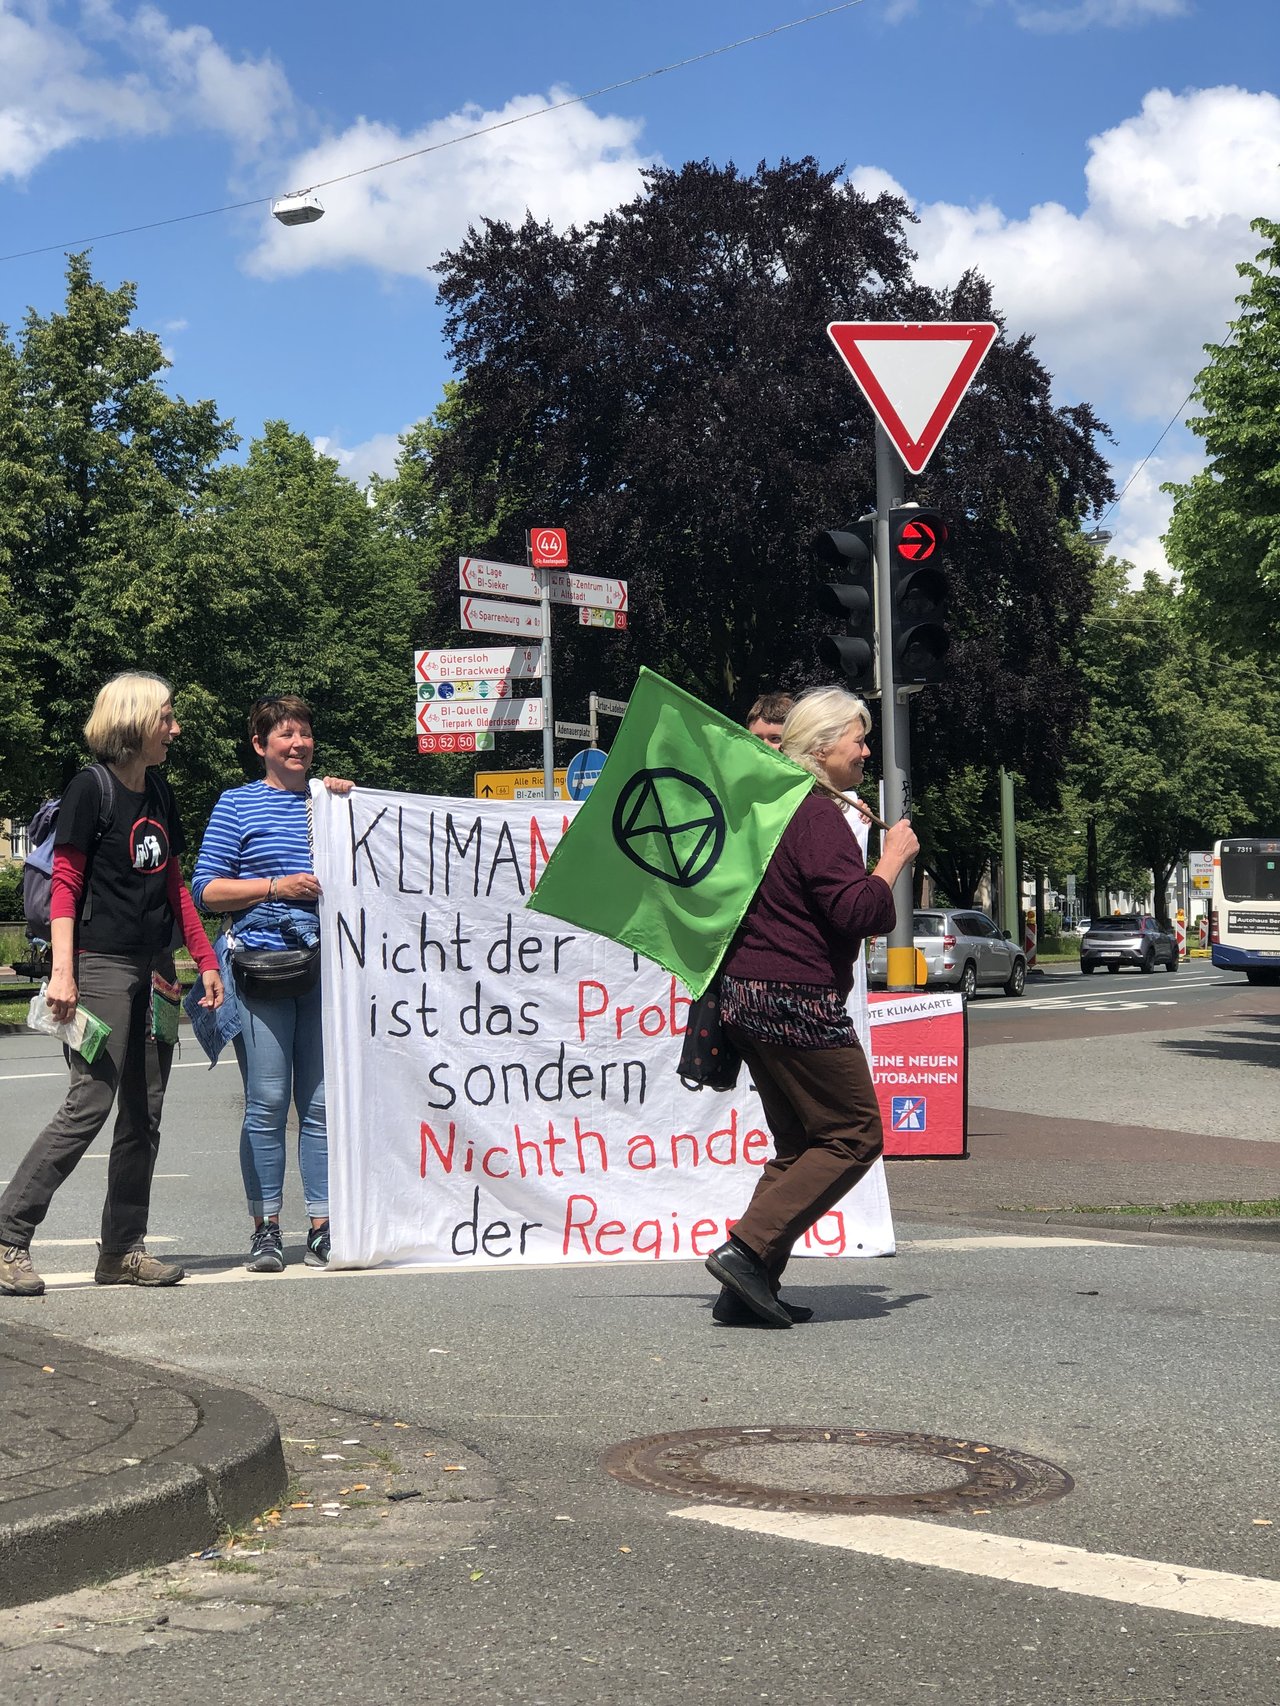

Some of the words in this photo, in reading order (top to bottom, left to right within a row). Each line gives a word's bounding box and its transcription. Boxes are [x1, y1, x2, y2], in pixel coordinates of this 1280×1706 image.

[541, 538, 558, 551] 44
[486, 566, 502, 578] Lage
[478, 578, 509, 591] BI-Sieker
[566, 579, 603, 592] BI-Zentrum
[560, 590, 586, 601] Altstadt
[479, 610, 520, 627] Sparrenburg
[617, 613, 626, 624] 21
[440, 654, 489, 664] Gütersloh
[523, 651, 532, 661] 18
[440, 665, 511, 677] BI-Brackwede
[441, 705, 489, 716] BI-Quelle
[442, 719, 473, 729] Tierpark
[476, 717, 520, 728] Olderdissen
[558, 725, 591, 738] Adenauerplatz
[421, 738, 434, 748] 53
[440, 737, 453, 748] 52
[459, 736, 472, 747] 50
[514, 778, 529, 786] Alle
[516, 790, 560, 799] BI-Zentm
[348, 799, 569, 897] KLIMAN
[337, 907, 473, 974] Nicht
[486, 912, 577, 975] der
[370, 982, 439, 1038] ist
[460, 981, 540, 1037] das
[577, 975, 694, 1041] Prob
[887, 999, 953, 1017] KLIMAKARTE
[872, 1055, 905, 1067] EINE
[908, 1055, 958, 1067] NEUEN
[428, 1042, 646, 1110] sondern
[872, 1073, 958, 1084] UTOBAHNEN
[420, 1108, 769, 1179] Nichthande
[451, 1185, 543, 1257] der
